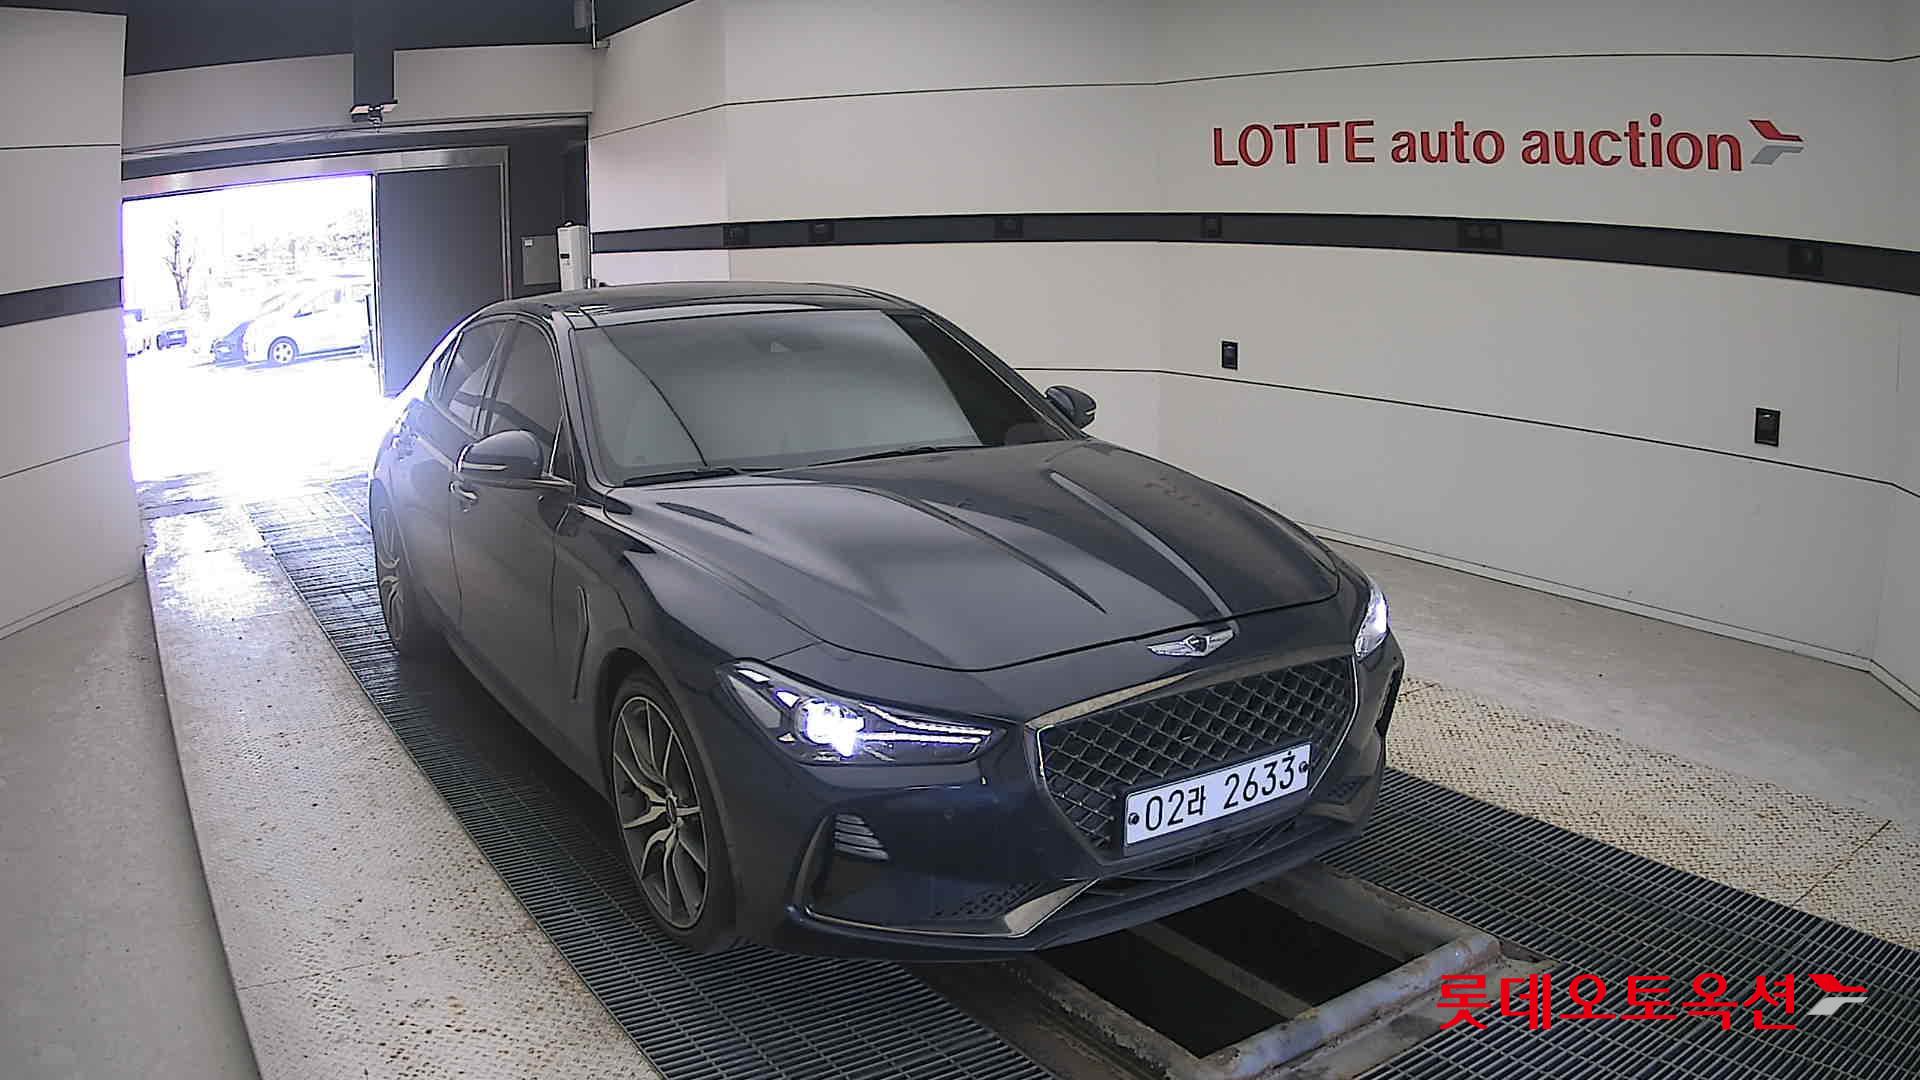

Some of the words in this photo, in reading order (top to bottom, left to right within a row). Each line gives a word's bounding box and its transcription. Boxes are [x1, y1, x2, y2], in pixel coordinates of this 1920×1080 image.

[1213, 120, 1376, 167] LOTTE
[1390, 120, 1505, 165] auto
[1521, 112, 1743, 172] auction
[1145, 785, 1206, 831] 02라
[1223, 753, 1296, 810] 2633
